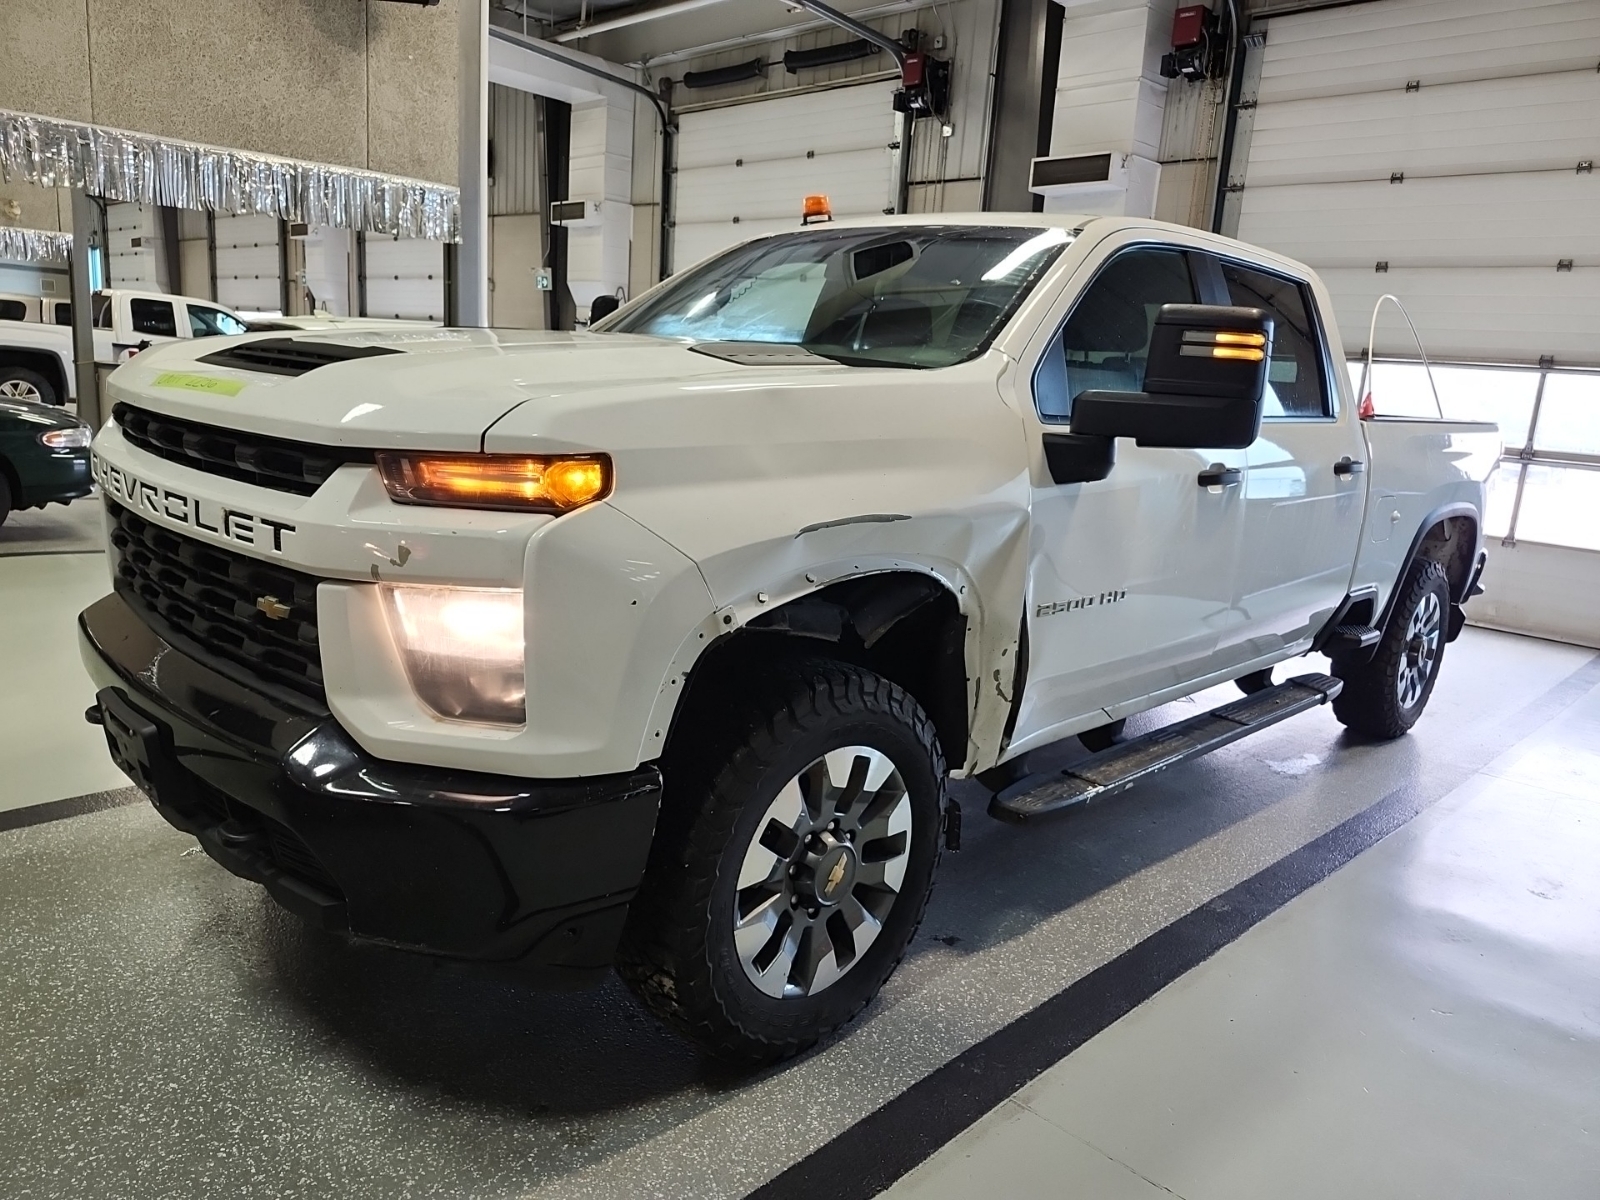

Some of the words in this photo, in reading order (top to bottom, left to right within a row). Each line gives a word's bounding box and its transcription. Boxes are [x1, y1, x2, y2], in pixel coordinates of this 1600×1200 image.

[90, 451, 297, 554] CHEVROLET
[1035, 596, 1095, 618] 2500
[1100, 588, 1128, 606] HD
